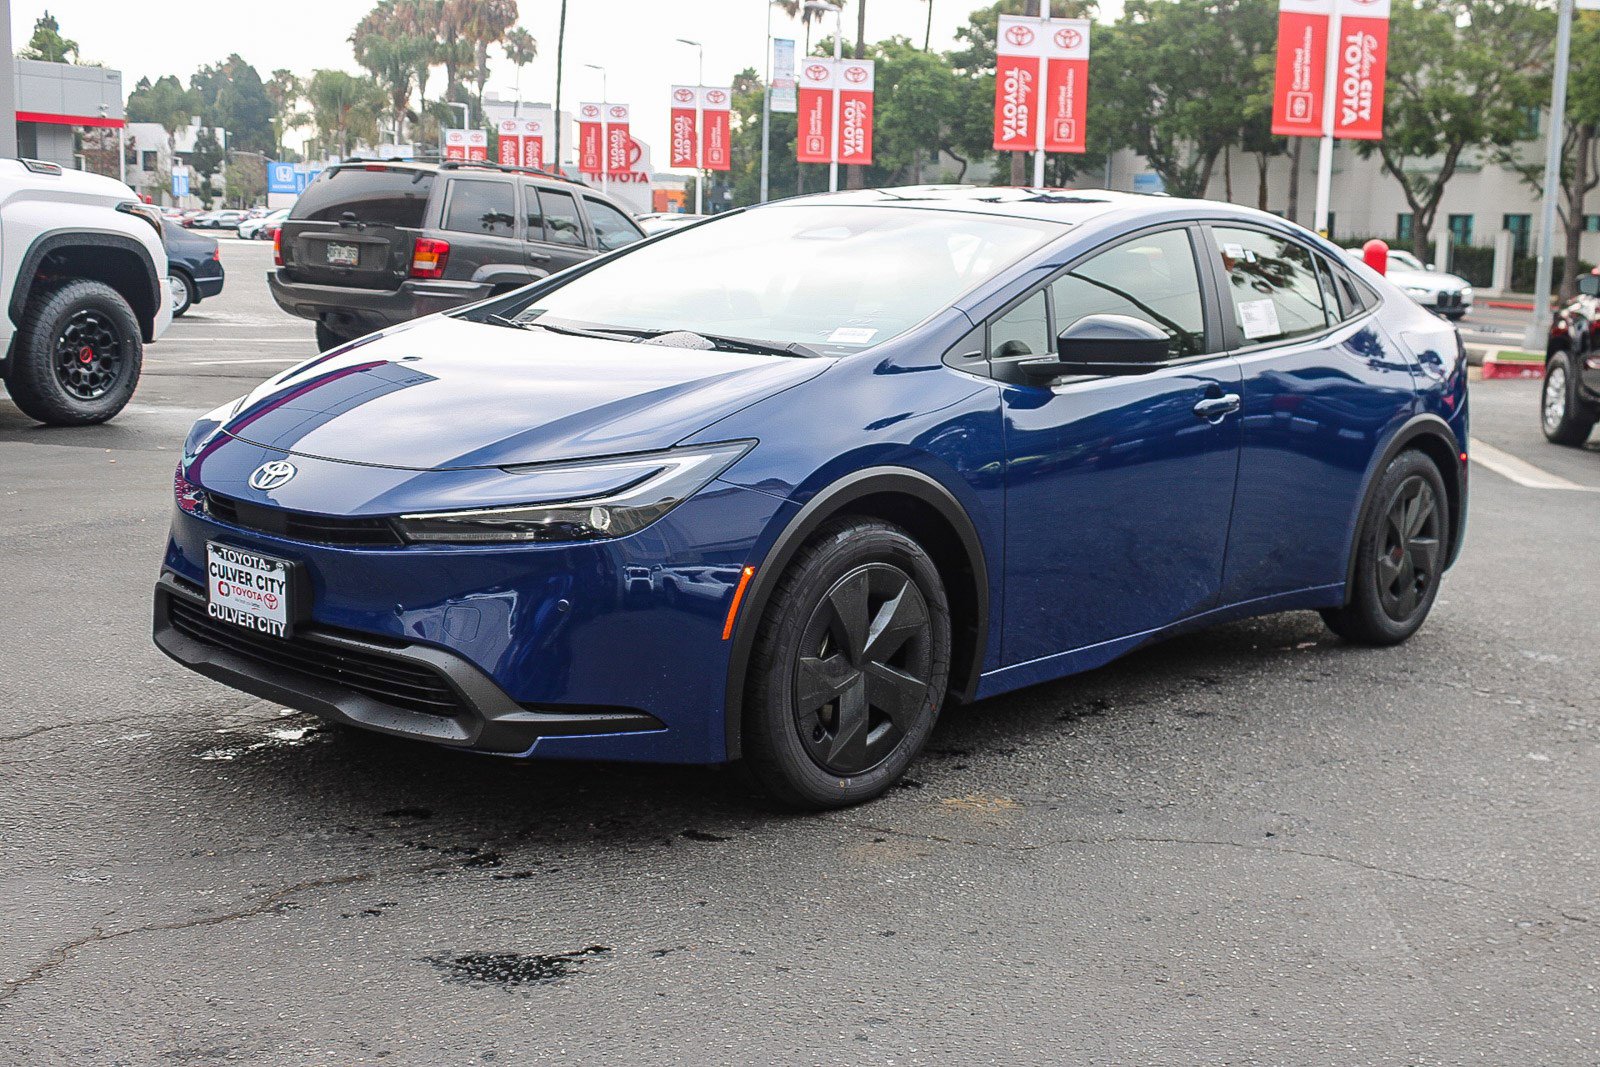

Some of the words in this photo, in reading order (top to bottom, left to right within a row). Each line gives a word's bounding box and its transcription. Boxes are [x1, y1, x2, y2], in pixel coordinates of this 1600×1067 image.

[1341, 31, 1363, 126] TOYOTA
[1002, 67, 1018, 141] TOYOTA
[1359, 79, 1373, 120] CITY
[674, 115, 684, 164] TOYOTA
[843, 99, 857, 157] TOYOTA
[1016, 104, 1029, 138] CITY
[610, 128, 619, 170] TOYOTA
[854, 127, 864, 154] CITY
[590, 171, 649, 183] TOYOTA
[209, 562, 253, 587] CULVER
[256, 574, 285, 595] CITY
[231, 585, 263, 602] TOYOTA
[208, 603, 255, 629] CULVER
[257, 617, 286, 638] CITY
